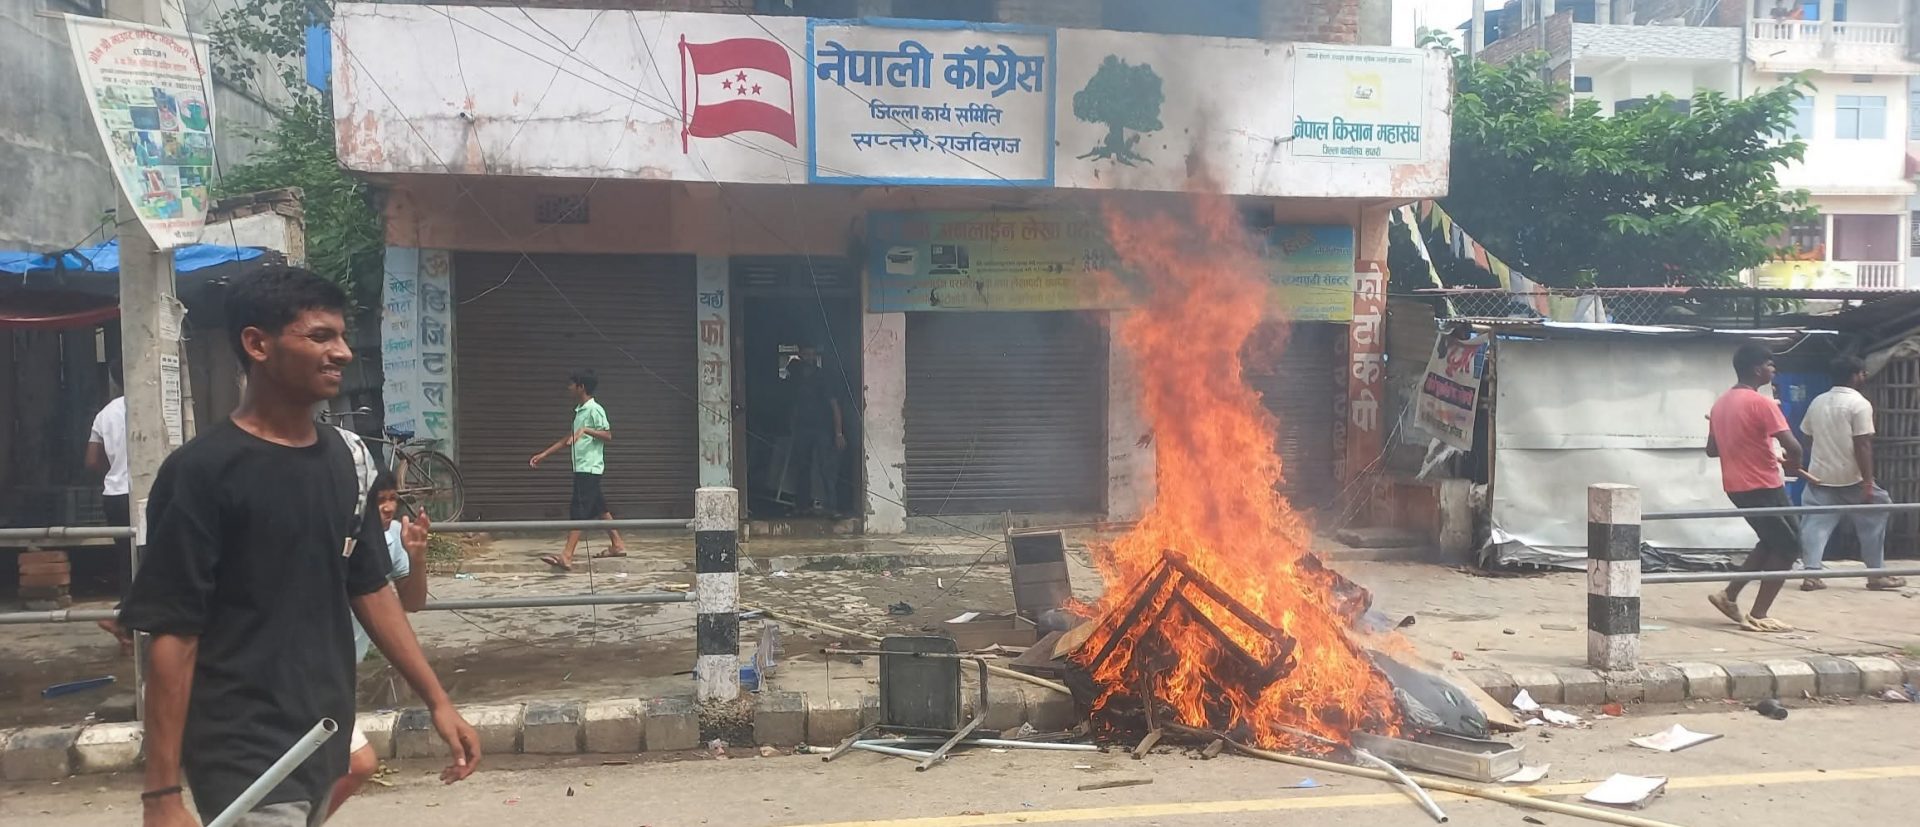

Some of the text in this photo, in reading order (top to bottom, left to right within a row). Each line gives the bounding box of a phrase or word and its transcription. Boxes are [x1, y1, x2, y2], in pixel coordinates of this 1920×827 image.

[817, 40, 1044, 98] नेपाली काँग्रेस
[870, 99, 1003, 126] जिल्ला कार्य समिति
[935, 132, 1021, 155] राजविराज
[1293, 115, 1421, 144] नेपाल किसान महासंघ
